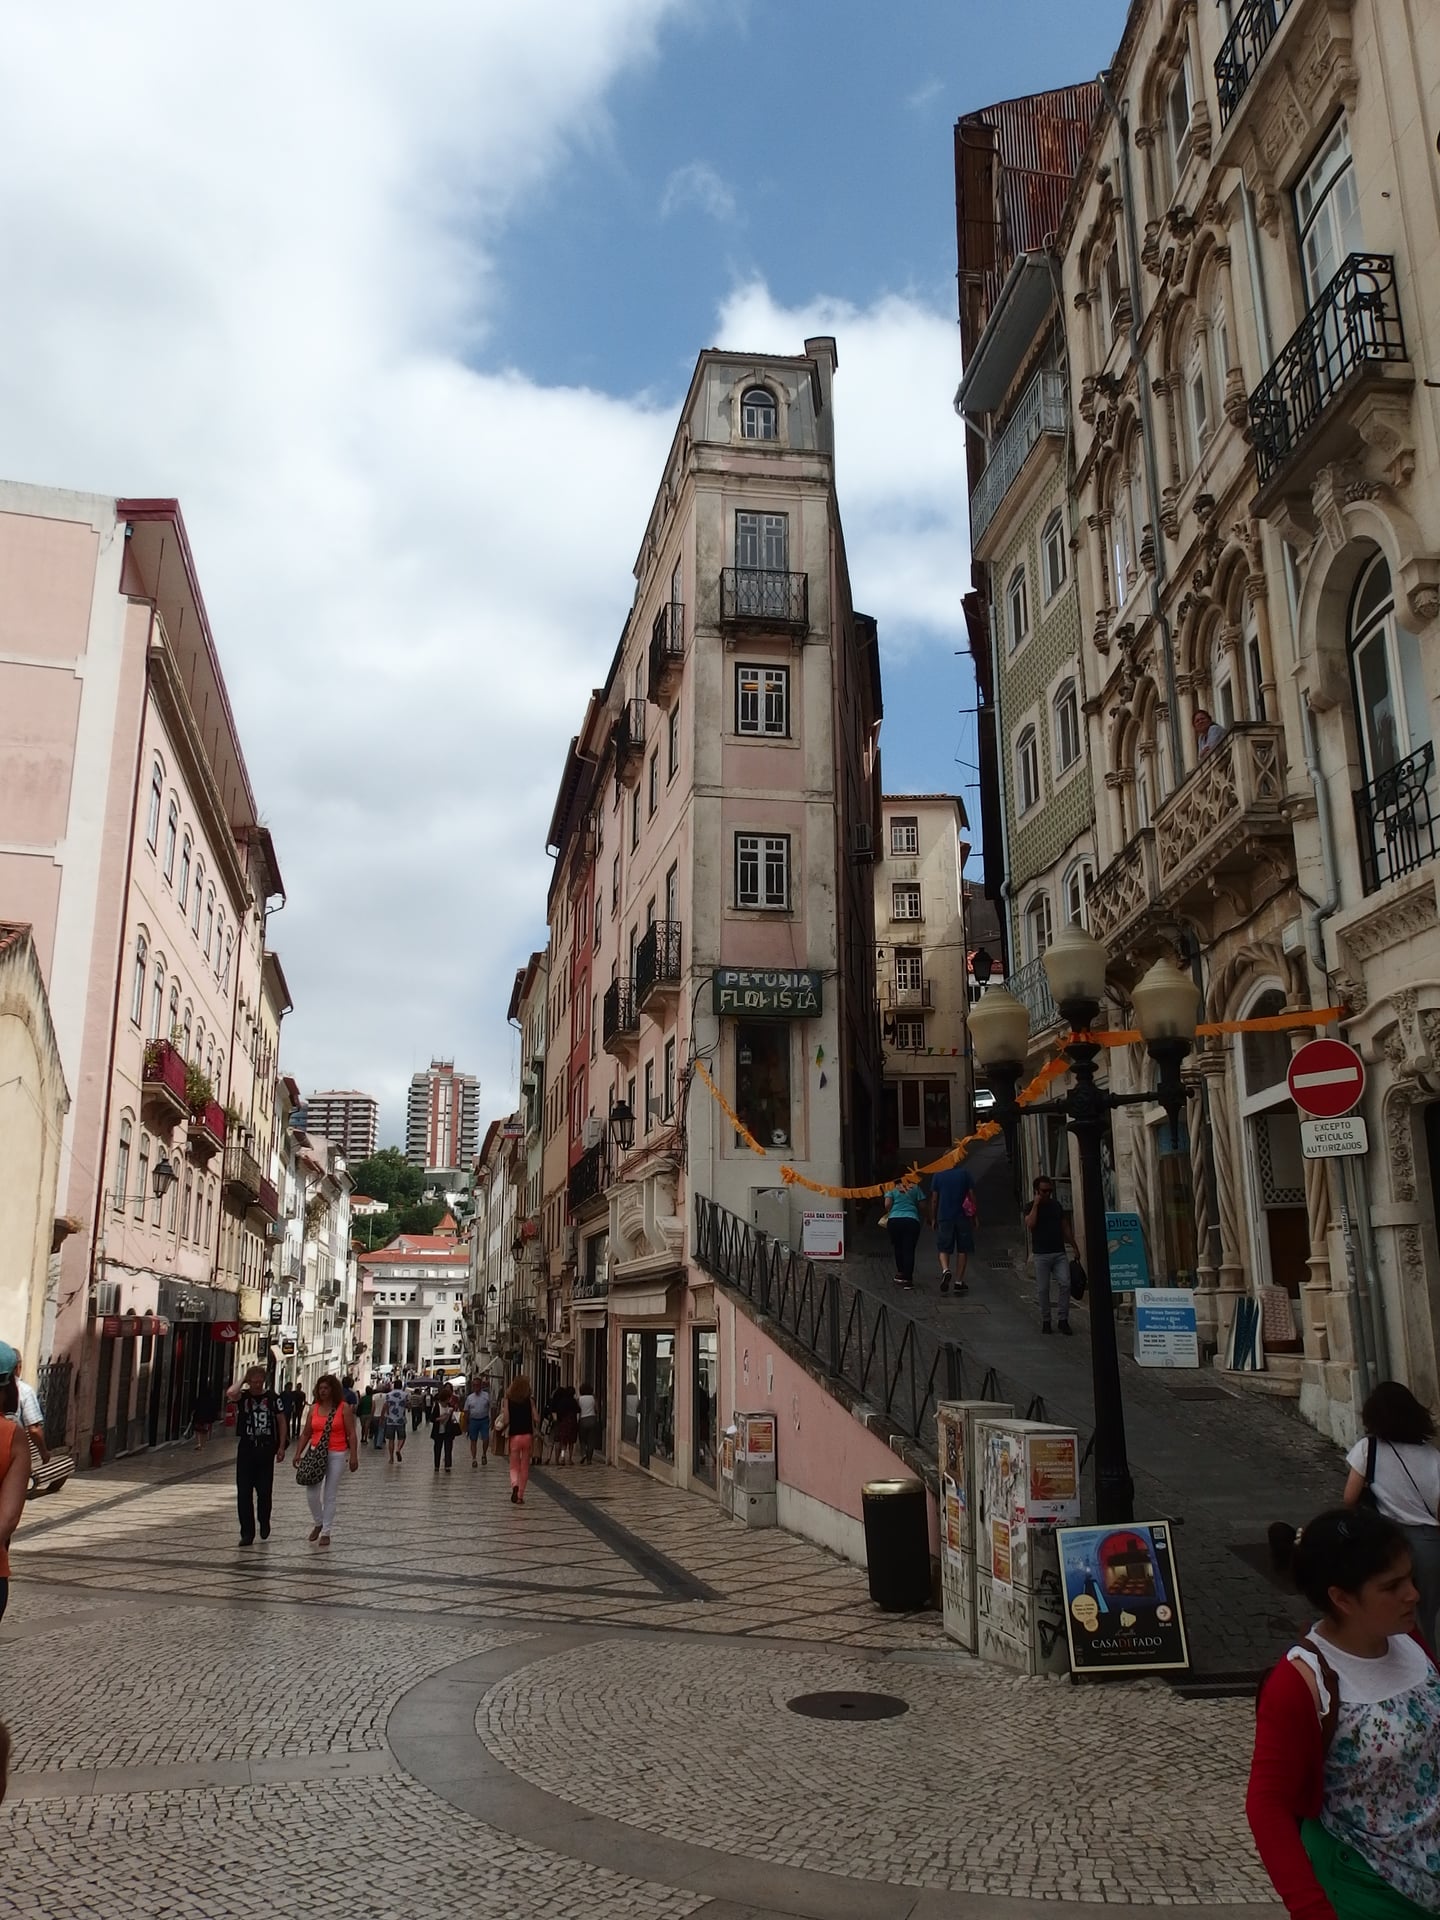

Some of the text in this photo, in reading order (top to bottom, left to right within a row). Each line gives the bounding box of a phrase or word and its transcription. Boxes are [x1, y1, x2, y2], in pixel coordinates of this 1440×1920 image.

[725, 971, 812, 988] PETUNIA
[1314, 1121, 1351, 1132] EXCEPTO
[1306, 1141, 1362, 1154] AUTORIZADOS
